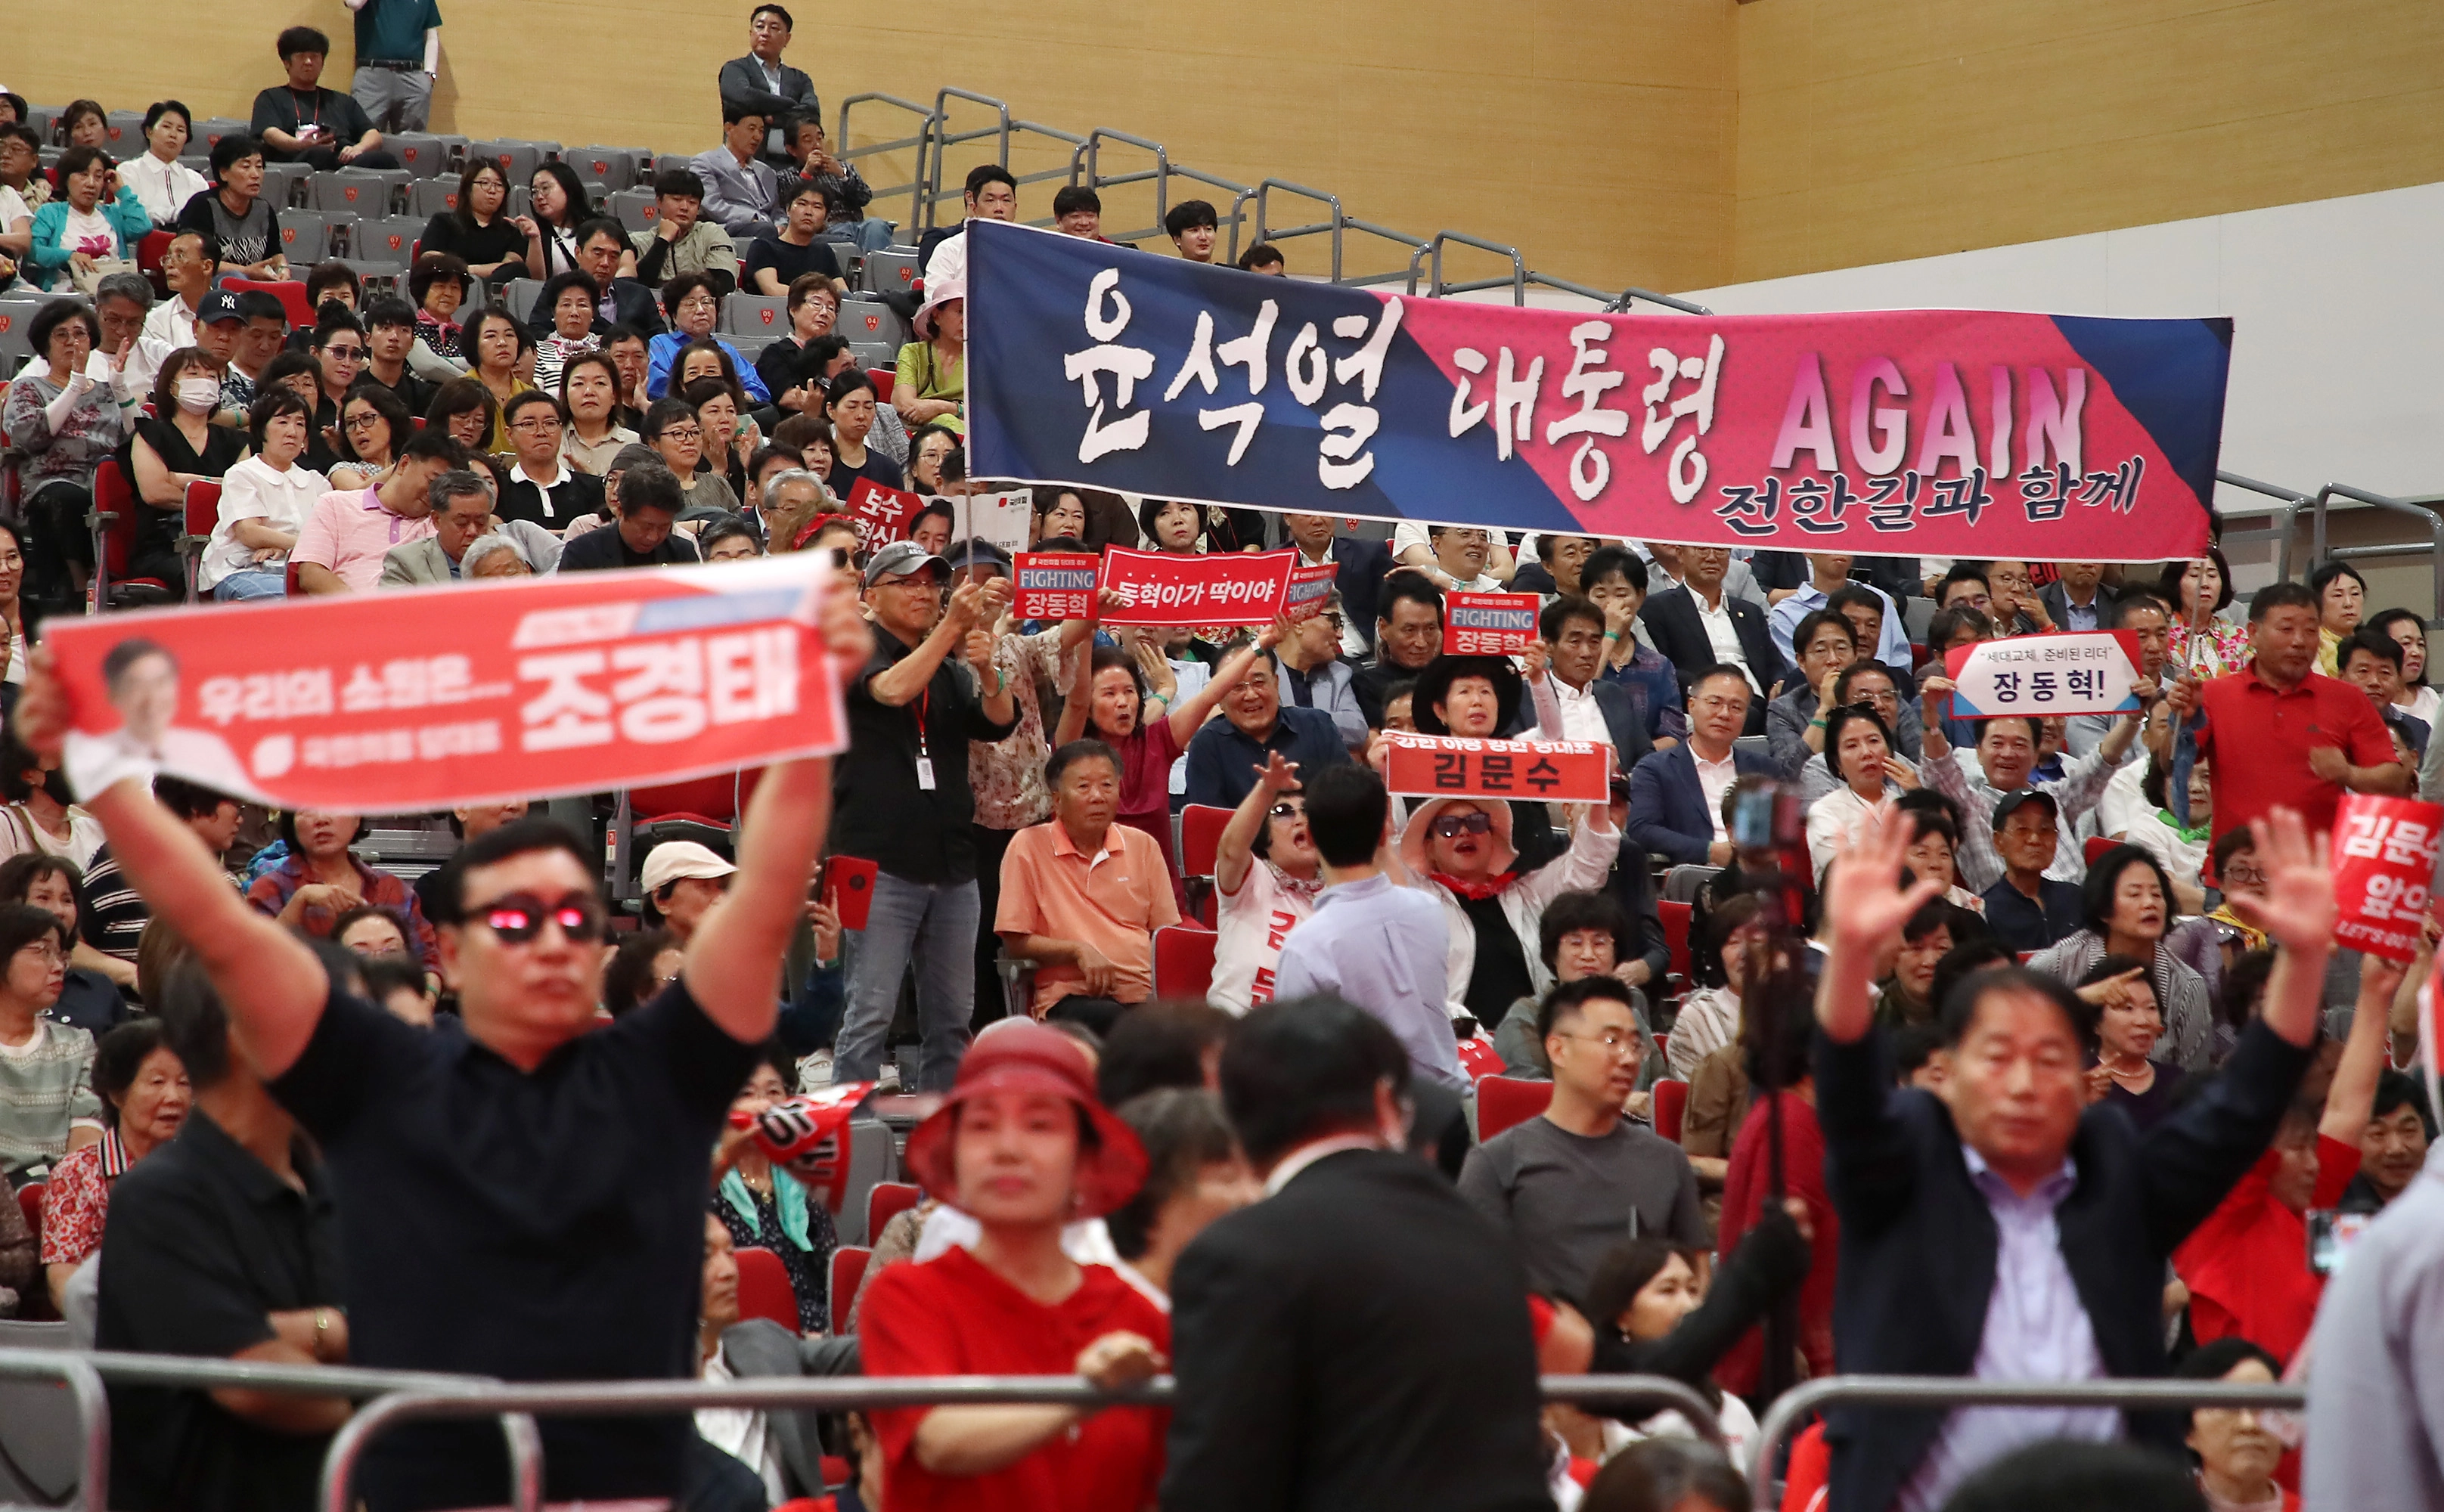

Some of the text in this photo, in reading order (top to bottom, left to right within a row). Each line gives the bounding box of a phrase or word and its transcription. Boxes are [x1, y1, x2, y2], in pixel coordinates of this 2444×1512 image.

[1064, 268, 2086, 504] 윤석열 대통령 AGAIN
[859, 488, 904, 523] 보수
[1713, 455, 2145, 537] 전한길과 함께
[854, 517, 898, 553] 혁신
[1020, 571, 1093, 587] FIGHTING
[1118, 578, 1276, 609] 동혁이가 딱이야
[1025, 593, 1088, 618] 장동혁
[1452, 610, 1534, 628] FIGHTING
[1456, 631, 1526, 654] 장동혁
[2044, 647, 2080, 662] 준비된
[198, 668, 334, 726] 우리의
[519, 626, 800, 753] 조경태
[1434, 753, 1561, 792] 김문수
